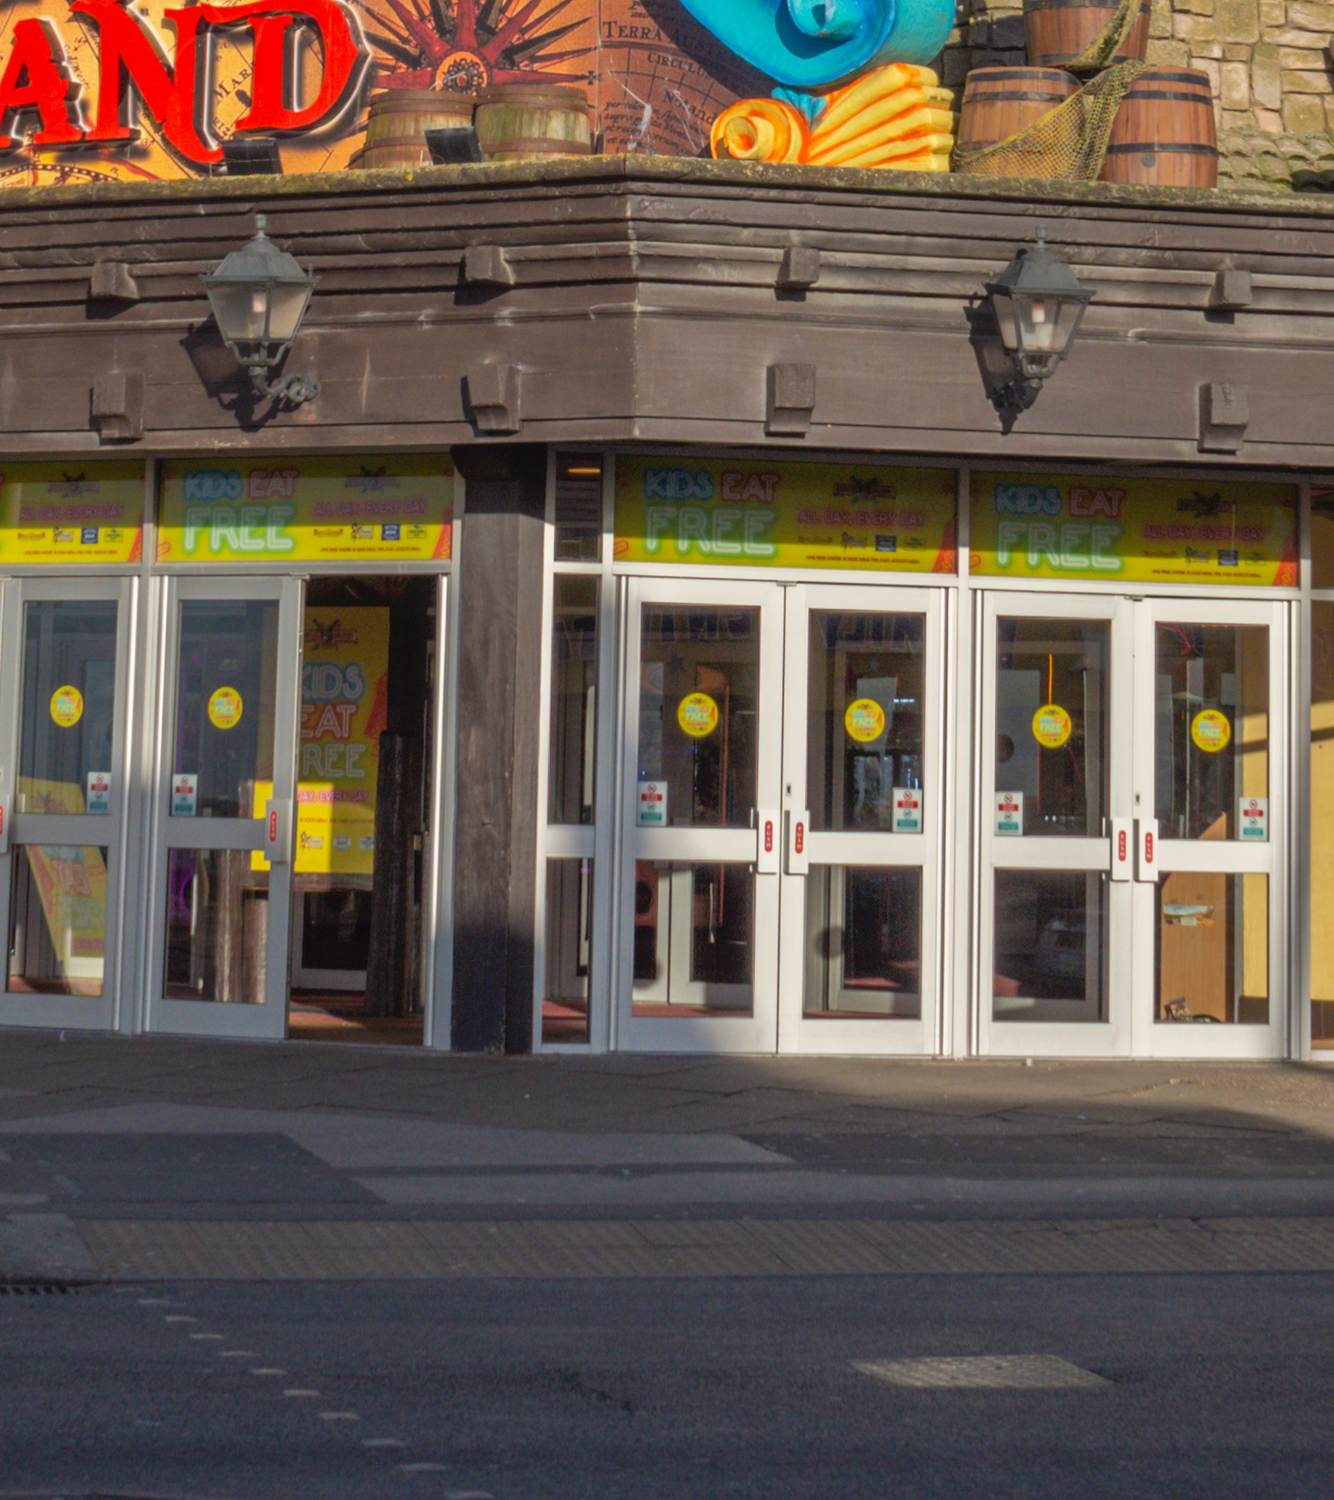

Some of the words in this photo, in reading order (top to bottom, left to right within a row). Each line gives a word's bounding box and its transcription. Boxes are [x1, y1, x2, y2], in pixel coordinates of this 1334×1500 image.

[603, 20, 663, 41] TERRA
[184, 470, 243, 499] KIDS
[248, 470, 298, 499] EAT
[644, 470, 713, 499] KIDS
[721, 472, 779, 501] EAT
[994, 485, 1063, 515] KIDS
[1069, 487, 1126, 517] EAT
[184, 505, 293, 551] FREE
[645, 506, 776, 555] FREE
[997, 521, 1122, 569] FREE
[300, 704, 356, 739] EAT
[302, 743, 366, 778] REE
